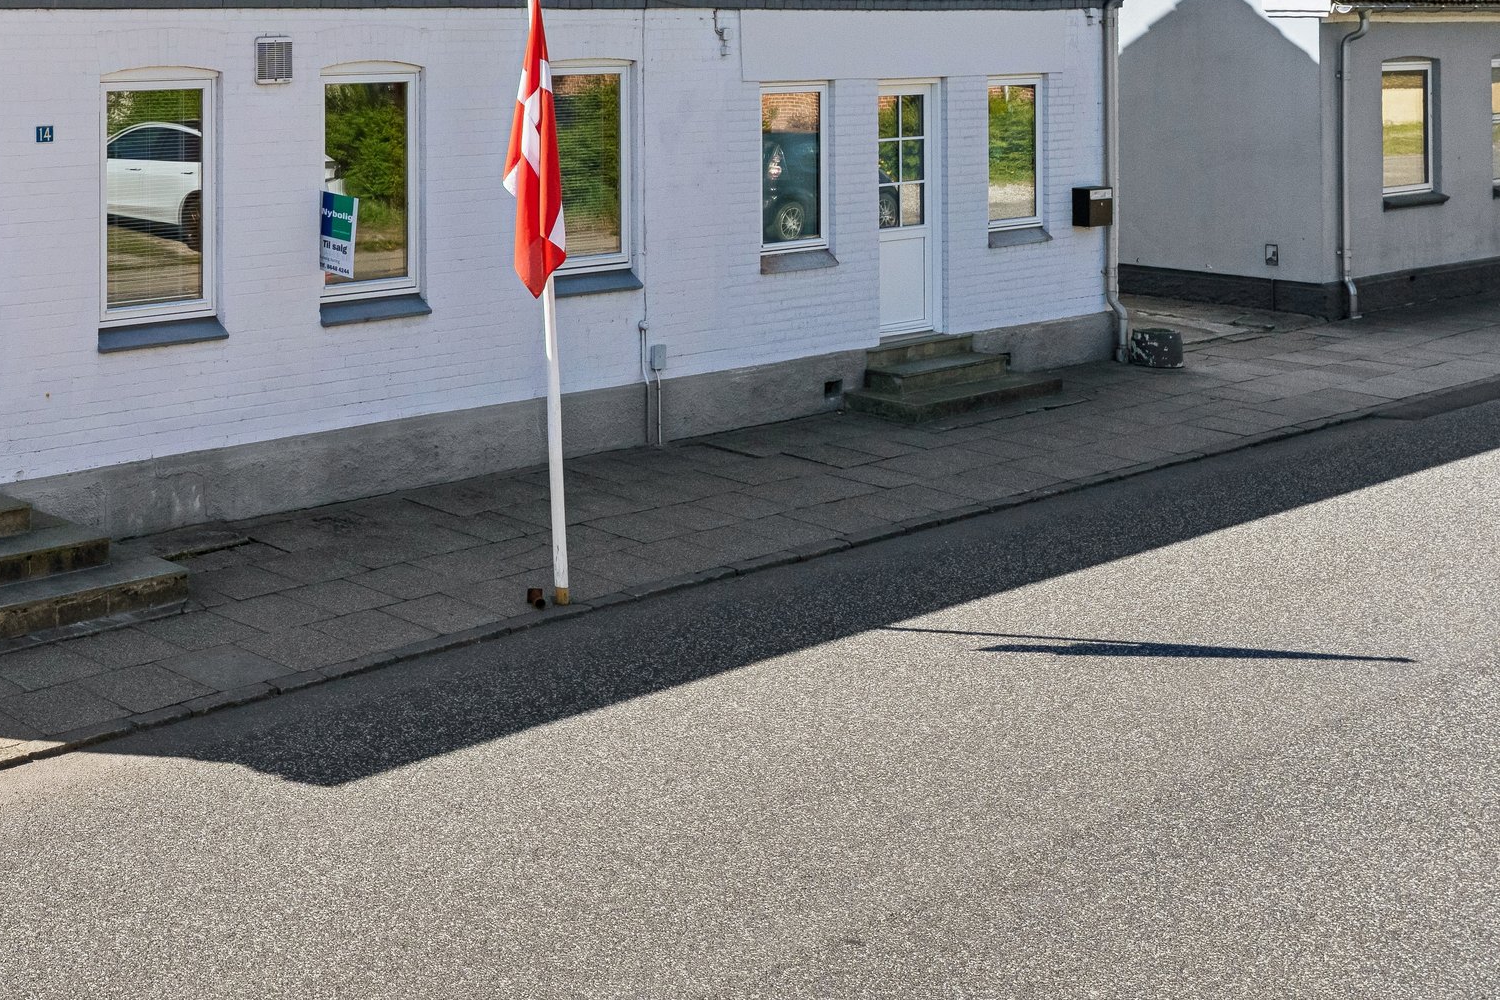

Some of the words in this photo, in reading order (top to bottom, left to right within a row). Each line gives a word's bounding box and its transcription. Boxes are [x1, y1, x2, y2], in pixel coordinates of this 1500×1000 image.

[39, 127, 52, 142] 14
[321, 208, 353, 223] Nybolig
[323, 240, 331, 249] Til
[332, 244, 348, 255] salg
